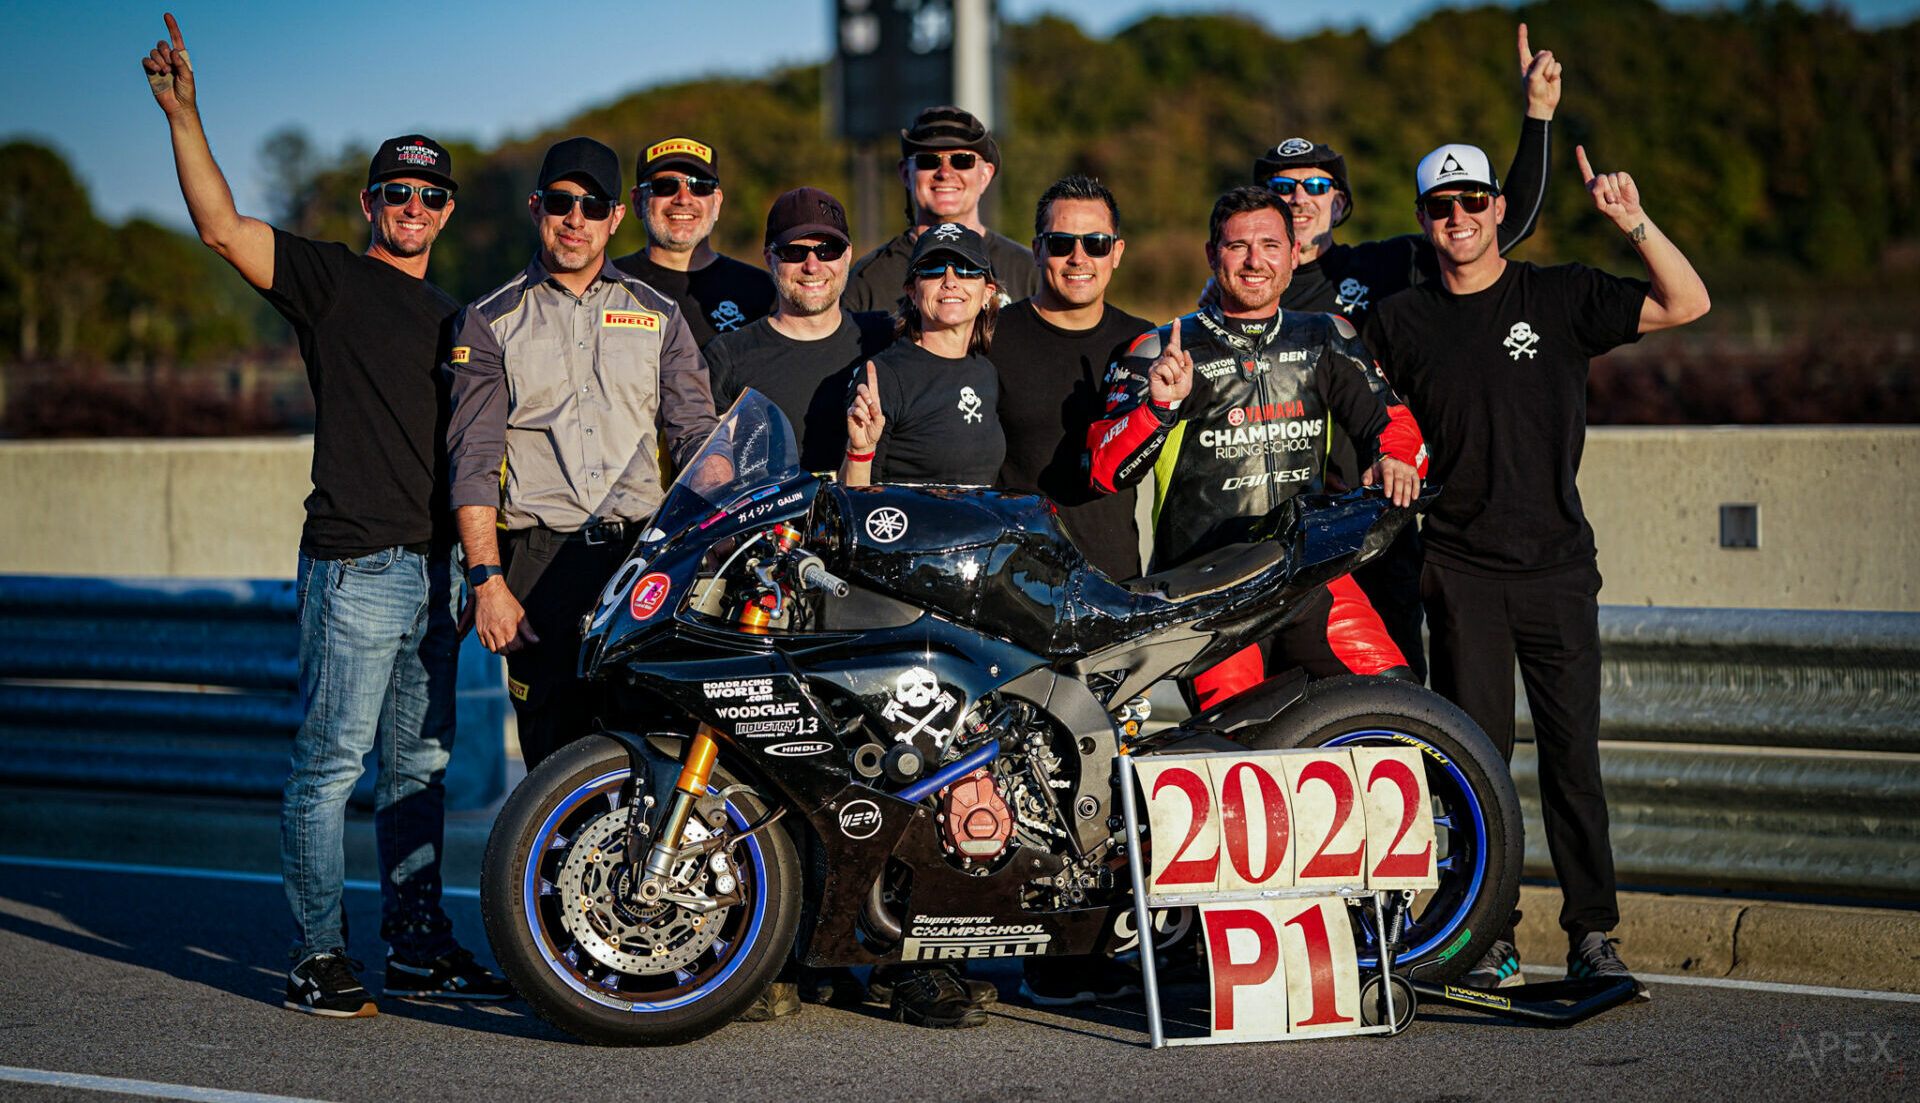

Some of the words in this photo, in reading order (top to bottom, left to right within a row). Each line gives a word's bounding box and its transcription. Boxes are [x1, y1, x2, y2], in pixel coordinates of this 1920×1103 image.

[395, 145, 439, 158] VISION
[651, 141, 707, 157] PIRELLI
[605, 313, 655, 328] PIRELLI
[1196, 311, 1248, 347] DAINESE
[1198, 358, 1236, 372] CUSTOM
[1279, 350, 1308, 363] BEN
[1203, 366, 1237, 379] WORKS
[1245, 400, 1305, 422] YAMAHA
[1199, 419, 1323, 448] CHAMPIONS
[1118, 433, 1166, 479] DAINESE
[1215, 443, 1261, 460] RIDING
[1264, 438, 1312, 455] SCHOOL
[1221, 466, 1311, 491] DAINESE
[738, 503, 774, 524] ガイジン
[777, 491, 804, 507] GAIJIN
[591, 557, 648, 630] 9
[703, 678, 774, 690] ROADRACING
[704, 685, 774, 699] WORLD
[745, 693, 774, 703] .com
[715, 702, 800, 719] WOODCRAFT
[735, 719, 796, 735] INDUSTRY
[795, 716, 819, 736] 13
[781, 744, 823, 753] HINDLE
[1392, 734, 1450, 765] PIRELLI
[1152, 759, 1432, 885] 2022
[912, 914, 995, 925] Supersprox
[901, 933, 1052, 961] PIRELLI
[1204, 903, 1354, 1031] P1
